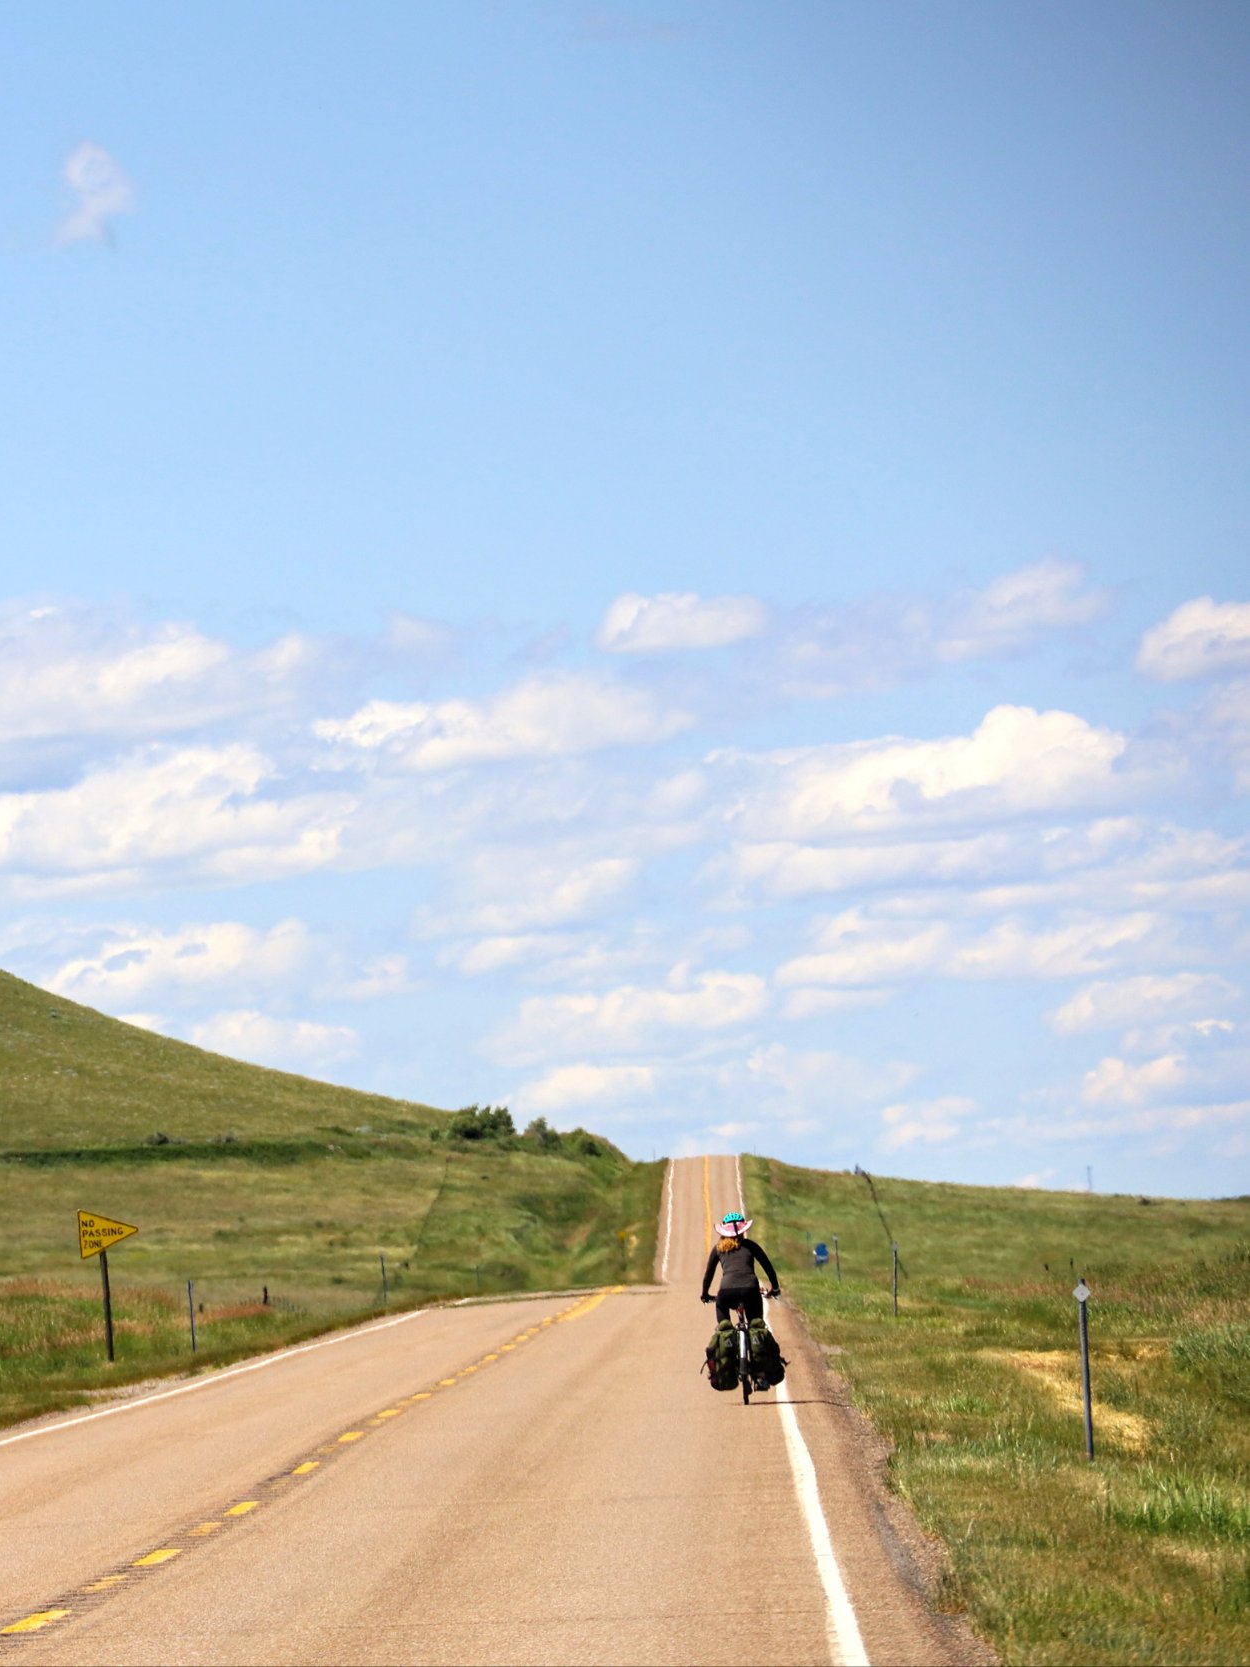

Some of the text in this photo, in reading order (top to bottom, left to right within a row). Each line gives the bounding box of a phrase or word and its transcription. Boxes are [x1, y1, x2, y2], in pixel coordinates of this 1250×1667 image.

[82, 1219, 95, 1228] NO
[82, 1227, 124, 1238] PASSING
[83, 1239, 103, 1249] ZONE
